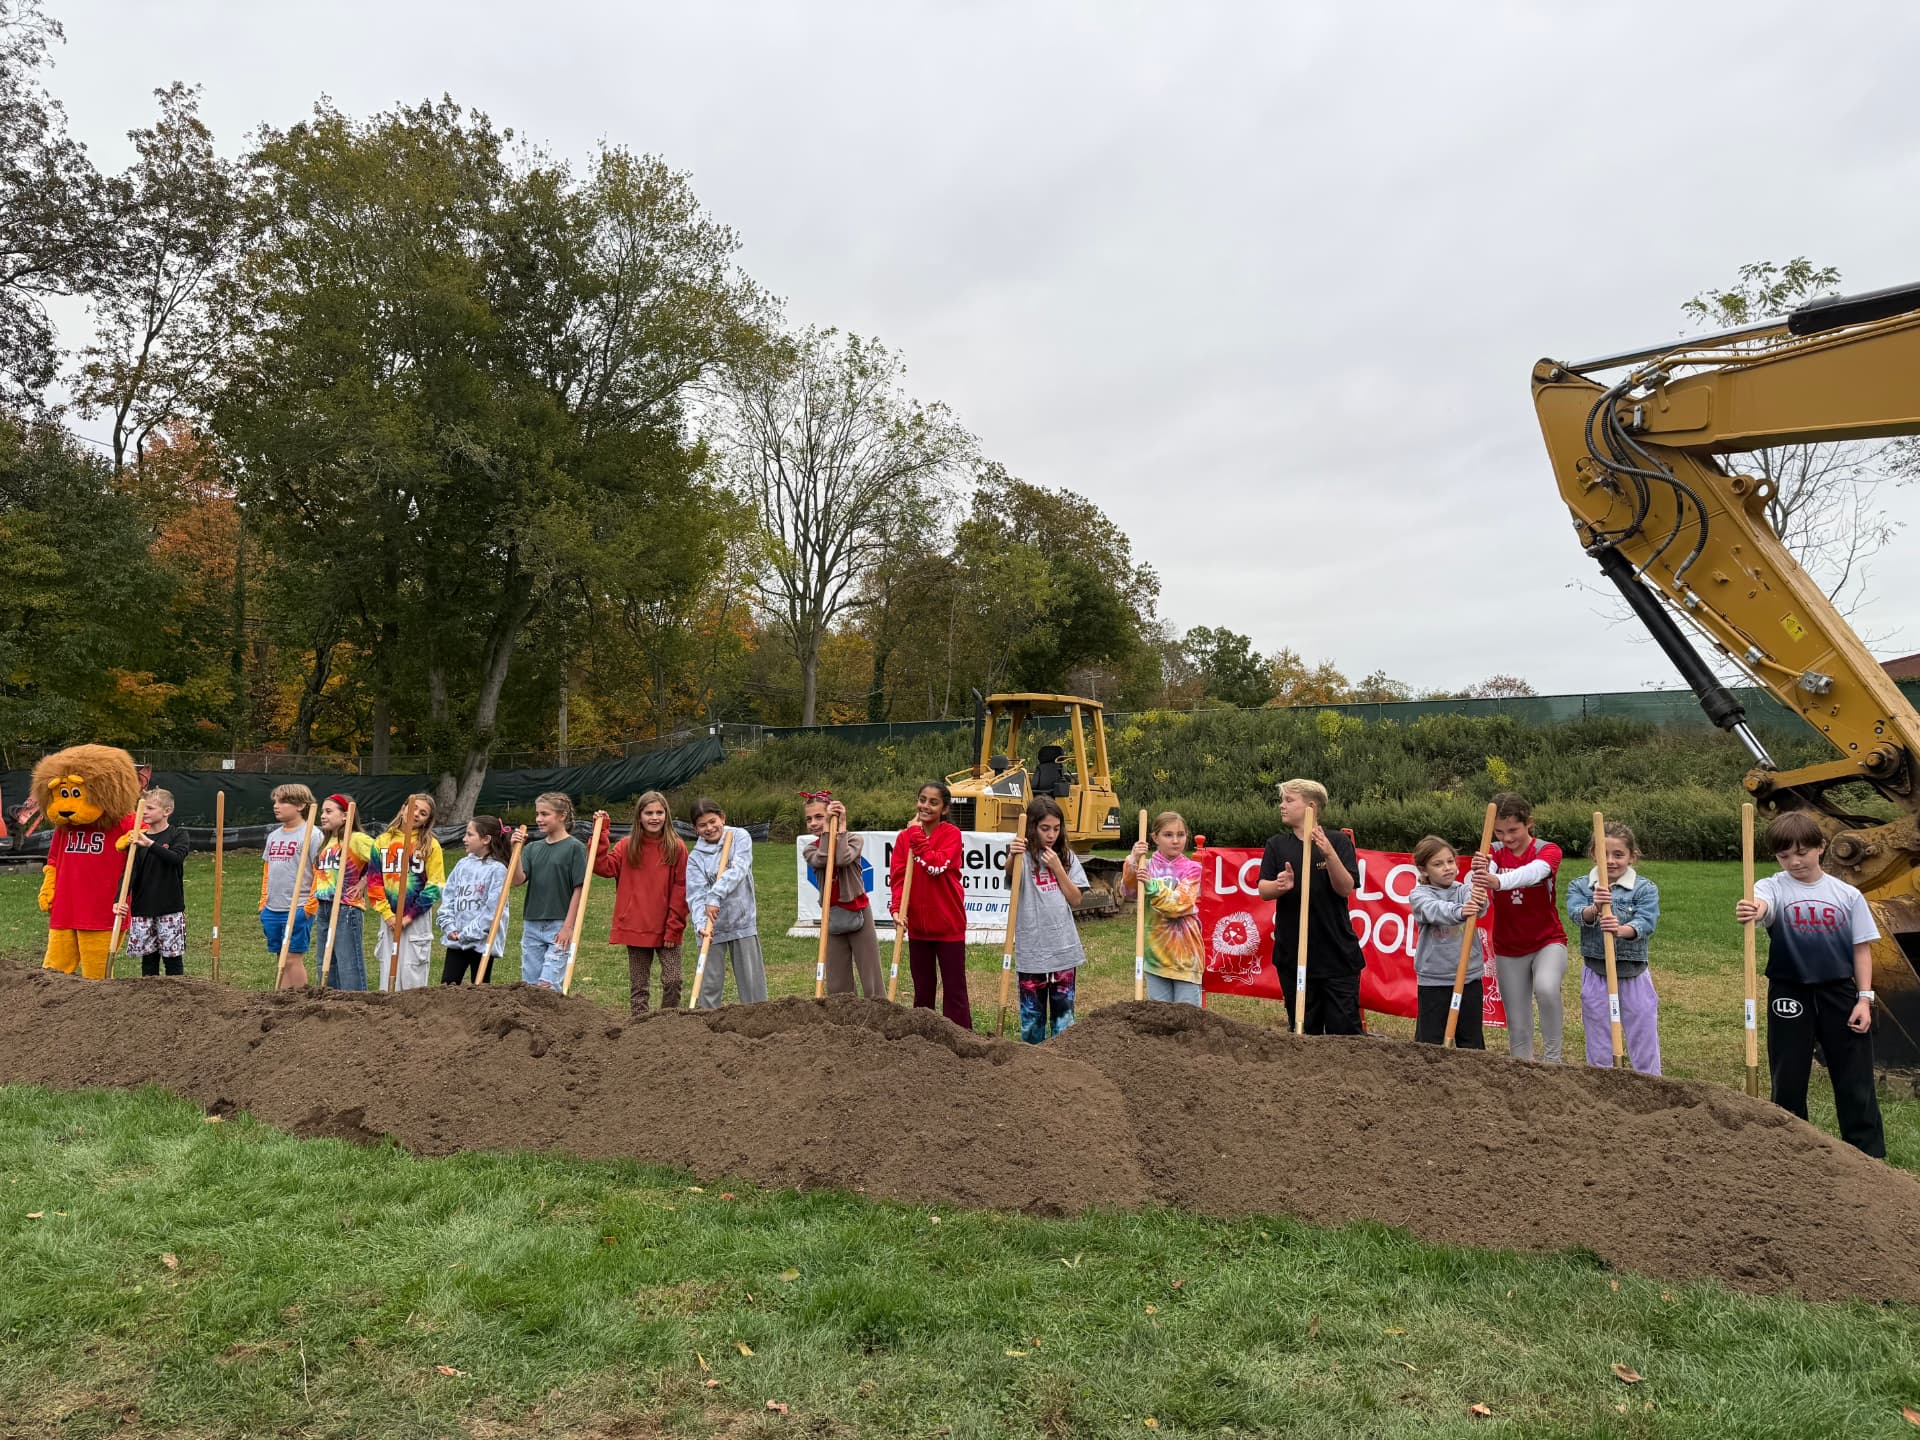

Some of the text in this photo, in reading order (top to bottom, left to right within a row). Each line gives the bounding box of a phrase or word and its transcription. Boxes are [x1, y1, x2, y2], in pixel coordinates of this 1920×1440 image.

[1008, 782, 1022, 797] CAT
[64, 831, 105, 855] LLS
[269, 840, 298, 857] LLS
[1032, 866, 1057, 886] LL
[965, 902, 982, 912] UILD
[985, 903, 998, 912] ON
[1793, 906, 1835, 927] LLS
[1776, 1000, 1797, 1014] LLS
